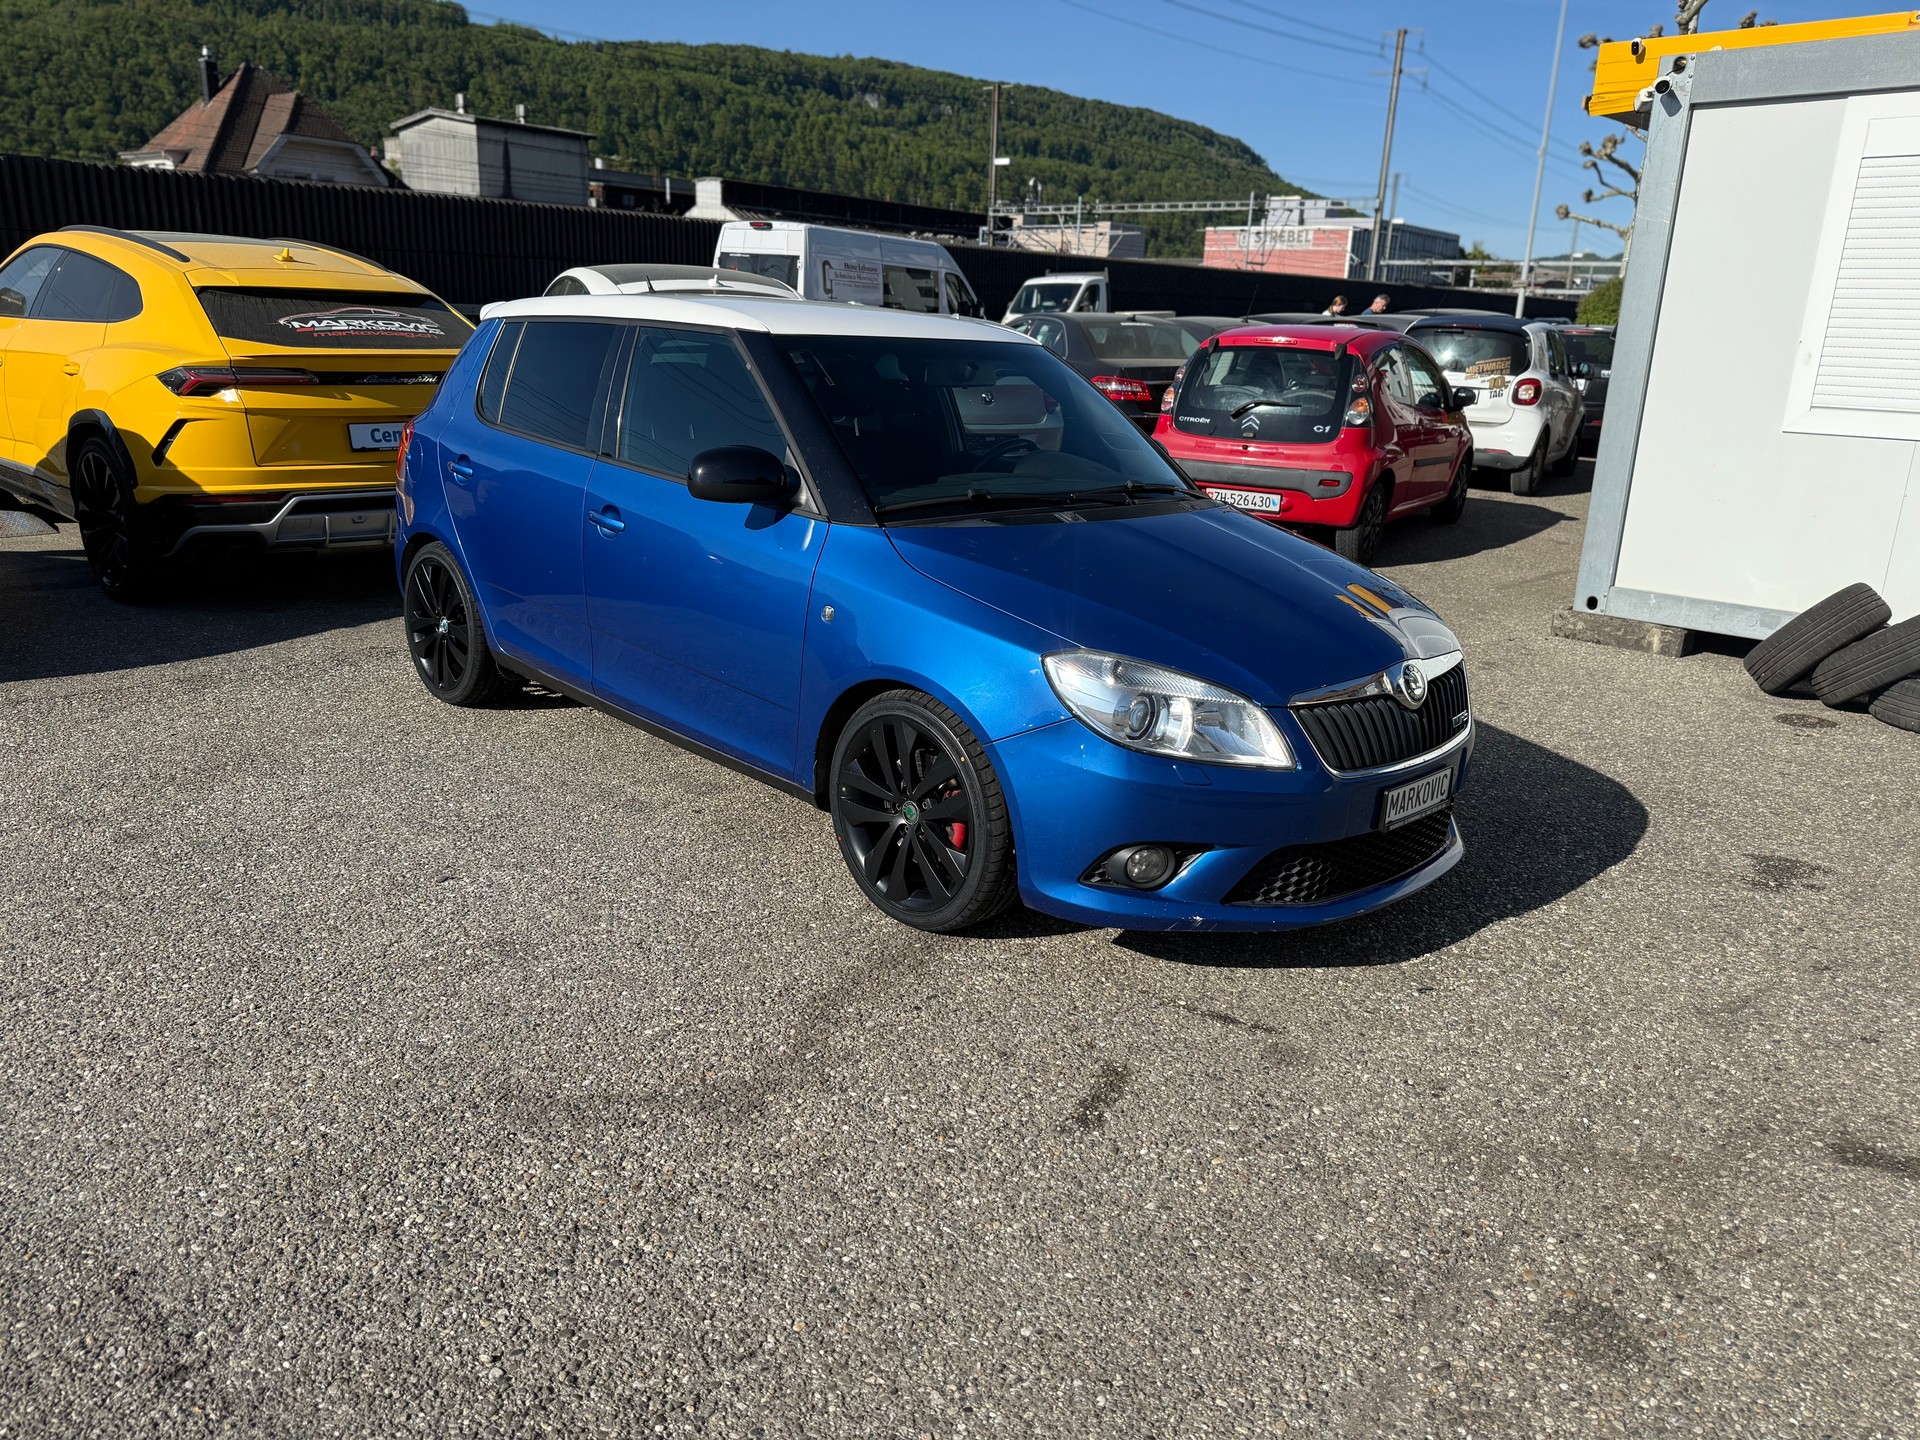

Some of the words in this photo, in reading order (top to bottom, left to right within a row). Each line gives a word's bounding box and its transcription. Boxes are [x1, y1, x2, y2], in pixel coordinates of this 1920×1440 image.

[291, 319, 441, 331] MARKOVIC
[1489, 389, 1504, 399] TAG
[1313, 425, 1331, 433] C1
[1388, 773, 1448, 818] MARKOVIC
